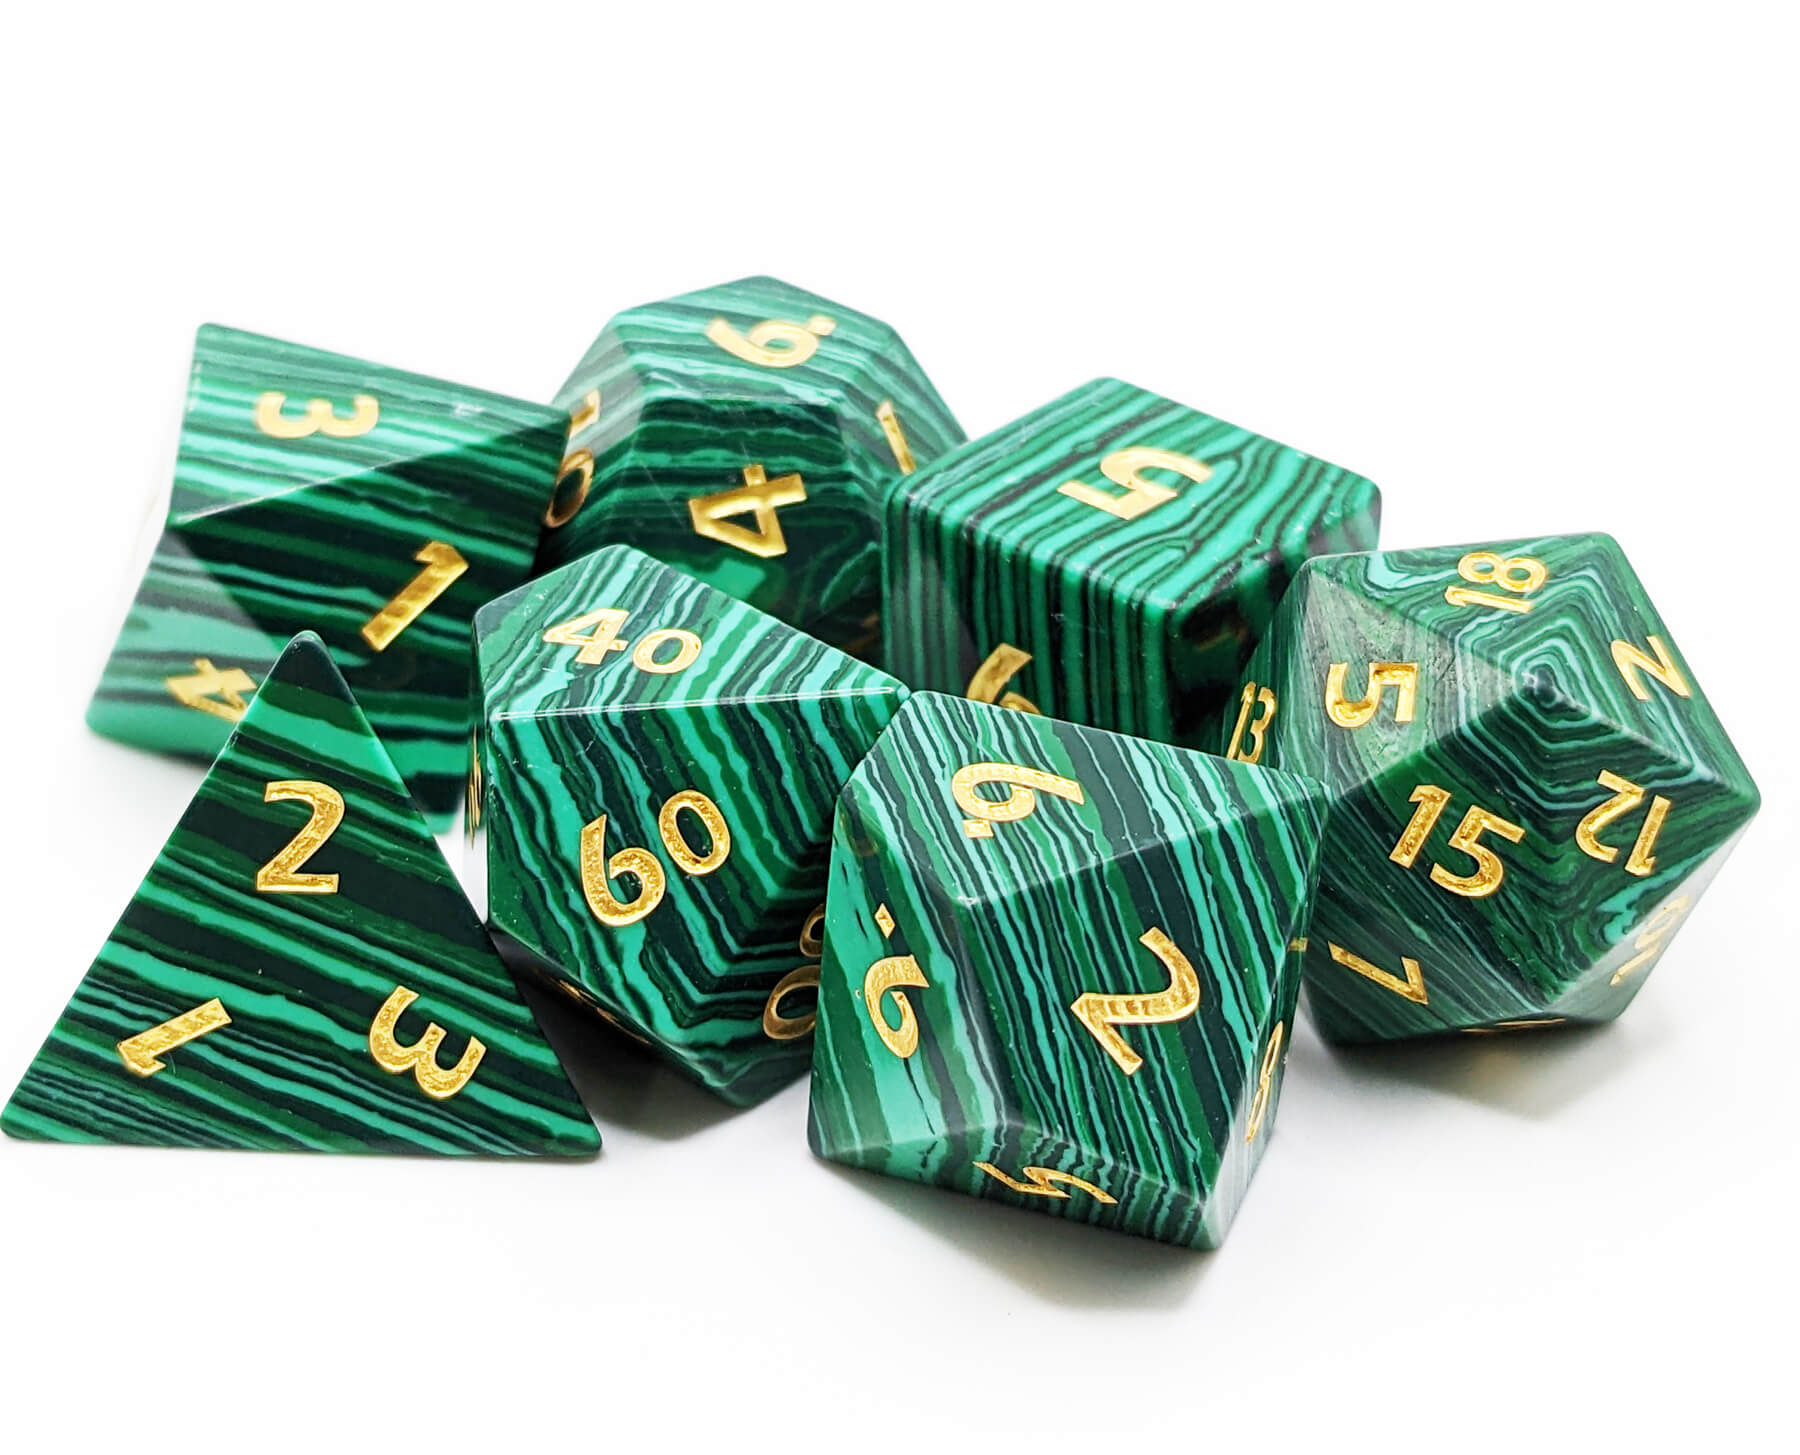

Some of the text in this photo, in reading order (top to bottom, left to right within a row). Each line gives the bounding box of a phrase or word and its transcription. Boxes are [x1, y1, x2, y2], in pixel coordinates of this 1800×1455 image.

[254, 393, 379, 439] 3
[687, 464, 808, 558] 4
[1058, 447, 1211, 521] 5
[361, 541, 470, 652] 1
[1445, 551, 1550, 614] 18
[542, 608, 703, 675] 40
[1610, 636, 1691, 701] 2
[166, 657, 257, 723] 4
[1227, 681, 1278, 763] 13
[1324, 661, 1420, 729] 5
[255, 780, 346, 894] 2
[580, 789, 732, 927] 60
[1389, 784, 1526, 898] 15
[1575, 769, 1672, 877] 12
[1069, 926, 1202, 1077] 2
[1328, 943, 1429, 1005] 7
[116, 996, 233, 1077] 1
[367, 986, 486, 1101] 3
[974, 1161, 1118, 1206] 5
